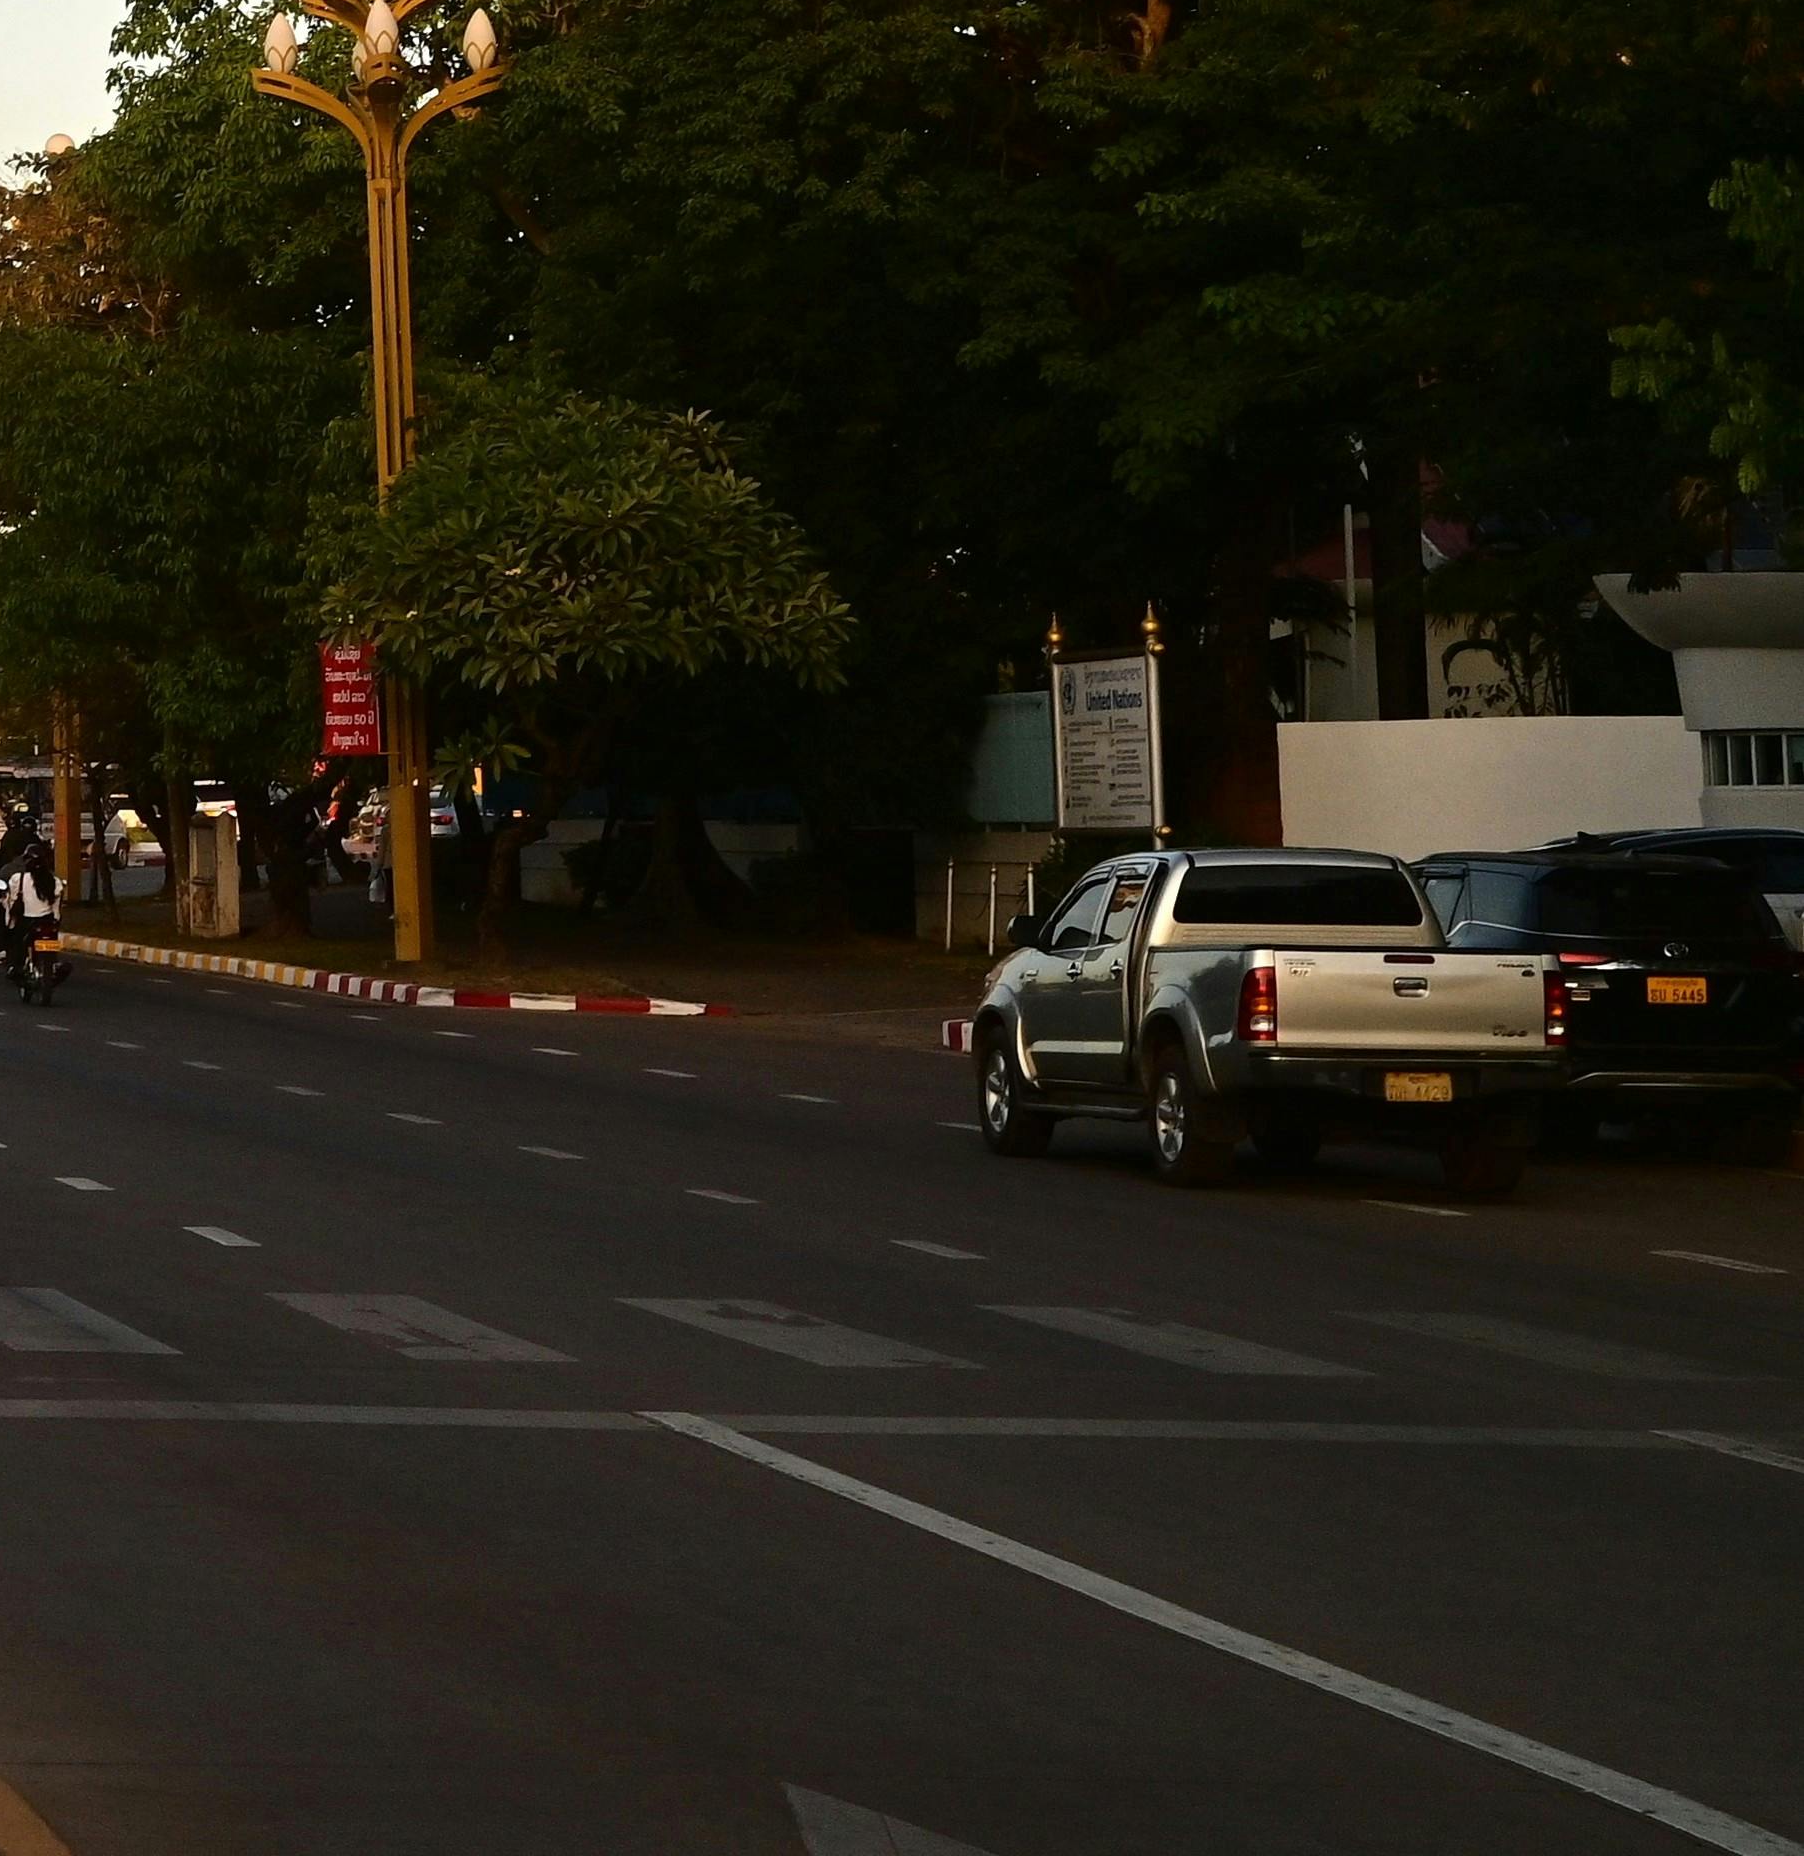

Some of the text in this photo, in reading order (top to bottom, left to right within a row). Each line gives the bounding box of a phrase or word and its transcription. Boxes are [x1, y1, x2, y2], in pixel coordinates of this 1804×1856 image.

[1085, 688, 1143, 711] United Nations
[354, 713, 367, 725] 50
[1672, 988, 1704, 1002] 5445
